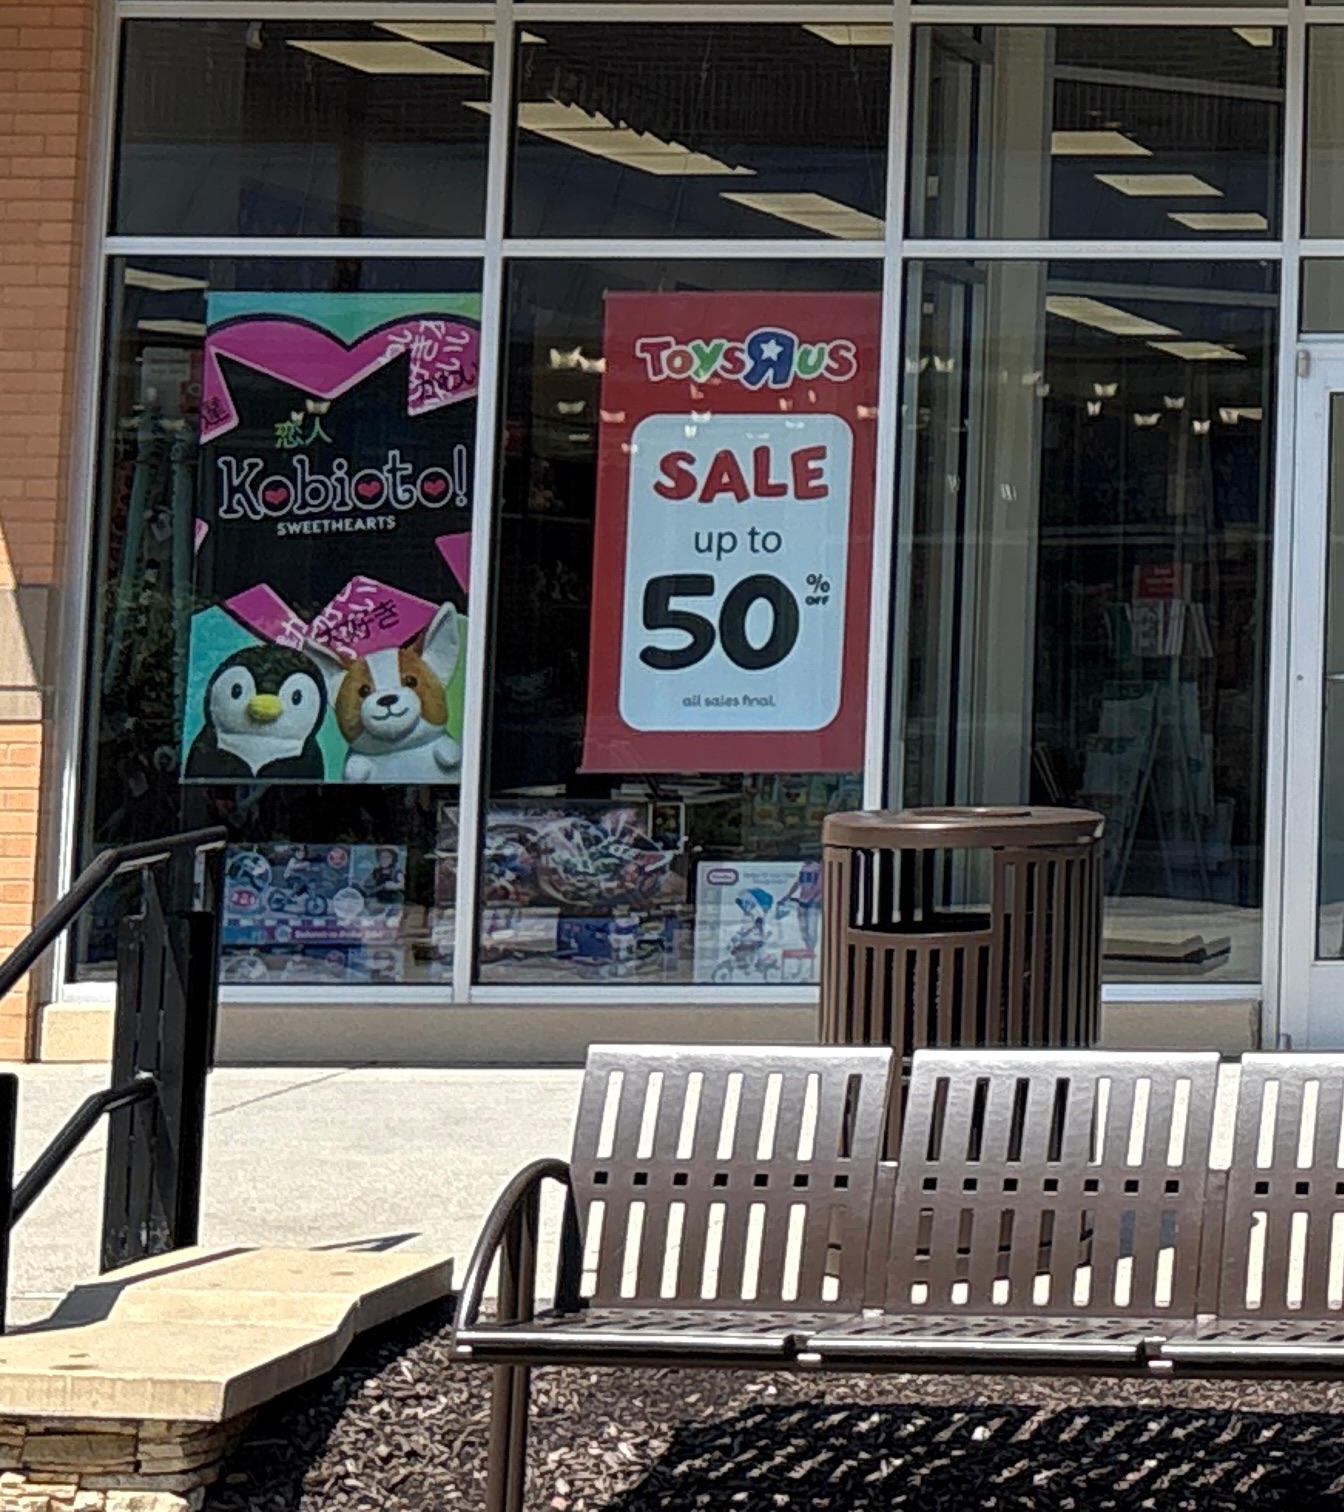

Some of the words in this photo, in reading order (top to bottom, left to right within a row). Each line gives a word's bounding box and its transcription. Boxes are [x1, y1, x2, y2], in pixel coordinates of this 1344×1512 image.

[653, 445, 829, 503] SALE
[276, 515, 396, 536] SWEETHEARTS
[693, 531, 738, 561] up
[747, 525, 783, 554] to
[804, 594, 830, 606] OFF
[704, 696, 740, 707] sales
